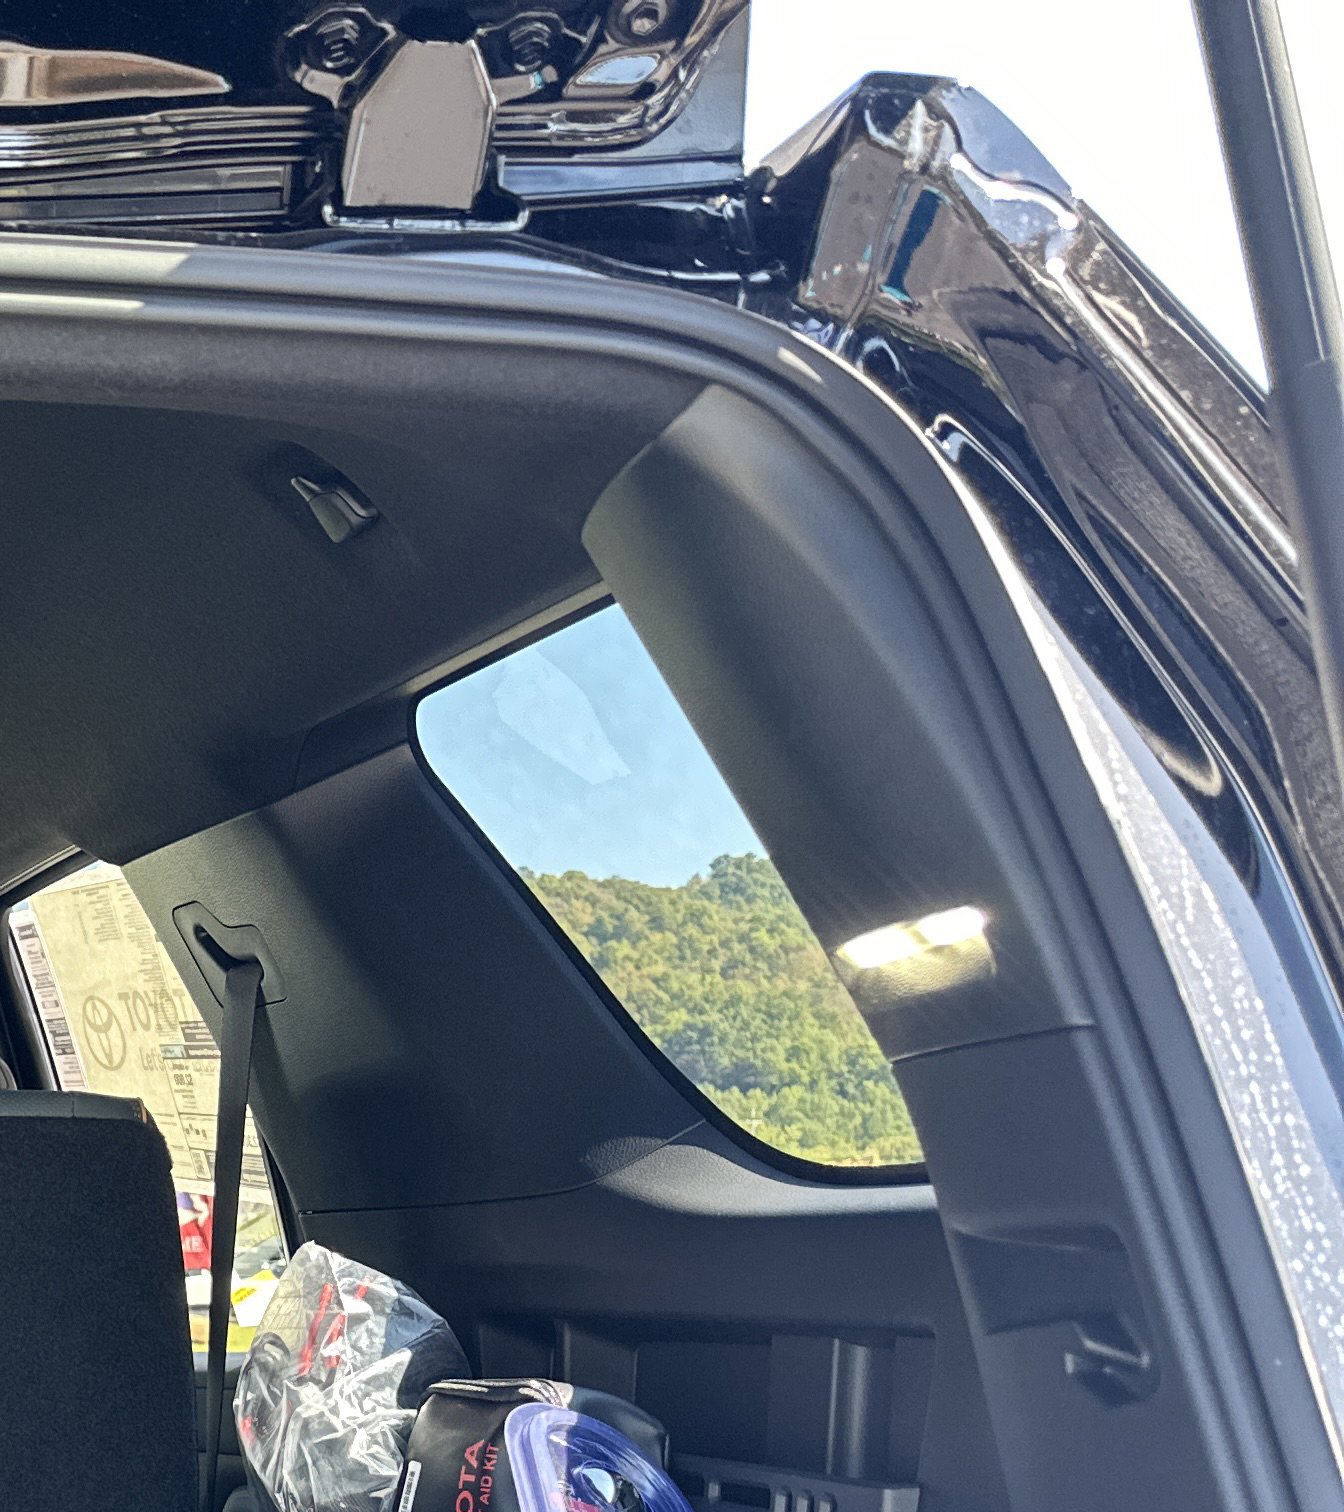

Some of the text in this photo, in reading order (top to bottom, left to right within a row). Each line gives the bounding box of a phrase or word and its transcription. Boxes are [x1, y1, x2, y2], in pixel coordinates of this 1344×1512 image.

[117, 988, 194, 1032] TOYOT
[483, 1441, 499, 1470] KIT
[479, 1475, 493, 1505] AID
